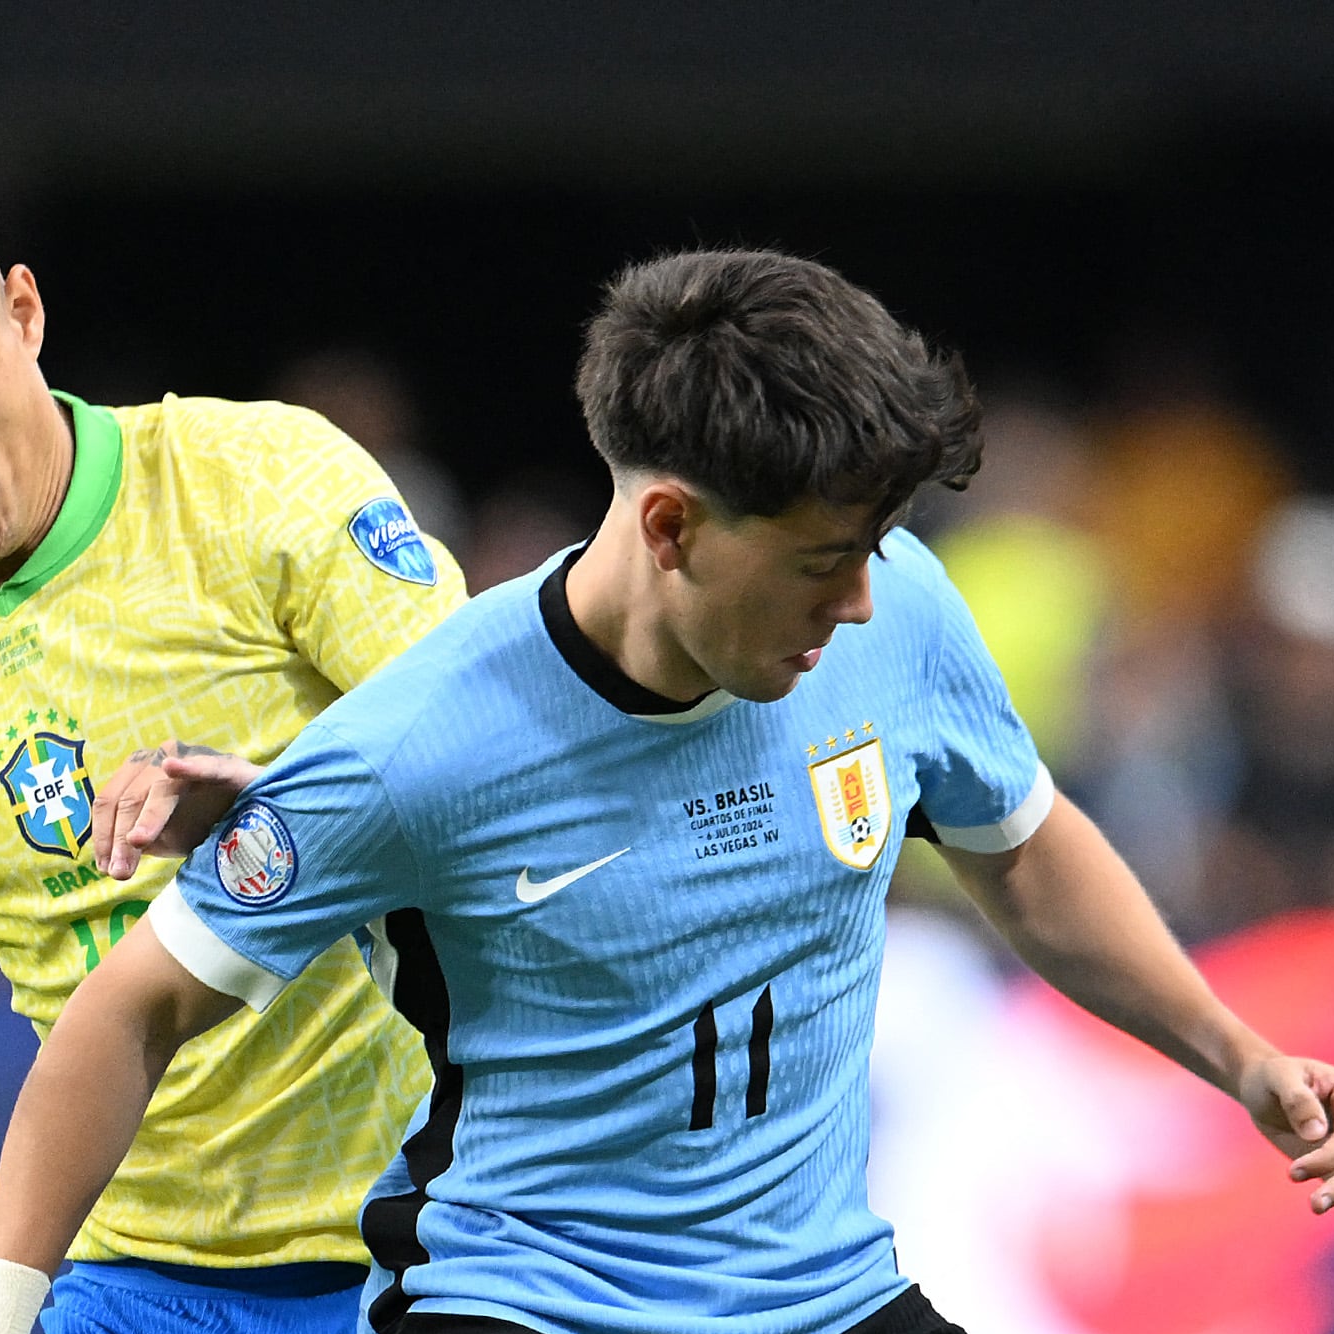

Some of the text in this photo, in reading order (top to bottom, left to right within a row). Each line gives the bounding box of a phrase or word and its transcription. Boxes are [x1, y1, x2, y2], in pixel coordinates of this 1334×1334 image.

[33, 775, 66, 804] CBF
[683, 782, 775, 818] VS. BRASIL
[843, 771, 865, 817] AUF
[690, 802, 774, 831] CUARTOS DE FINAL
[715, 825, 740, 839] JULIO
[742, 819, 764, 833] 2024
[695, 828, 779, 859] LAS VEGAS NV
[42, 860, 101, 898] BRA
[688, 982, 774, 1132] 11
